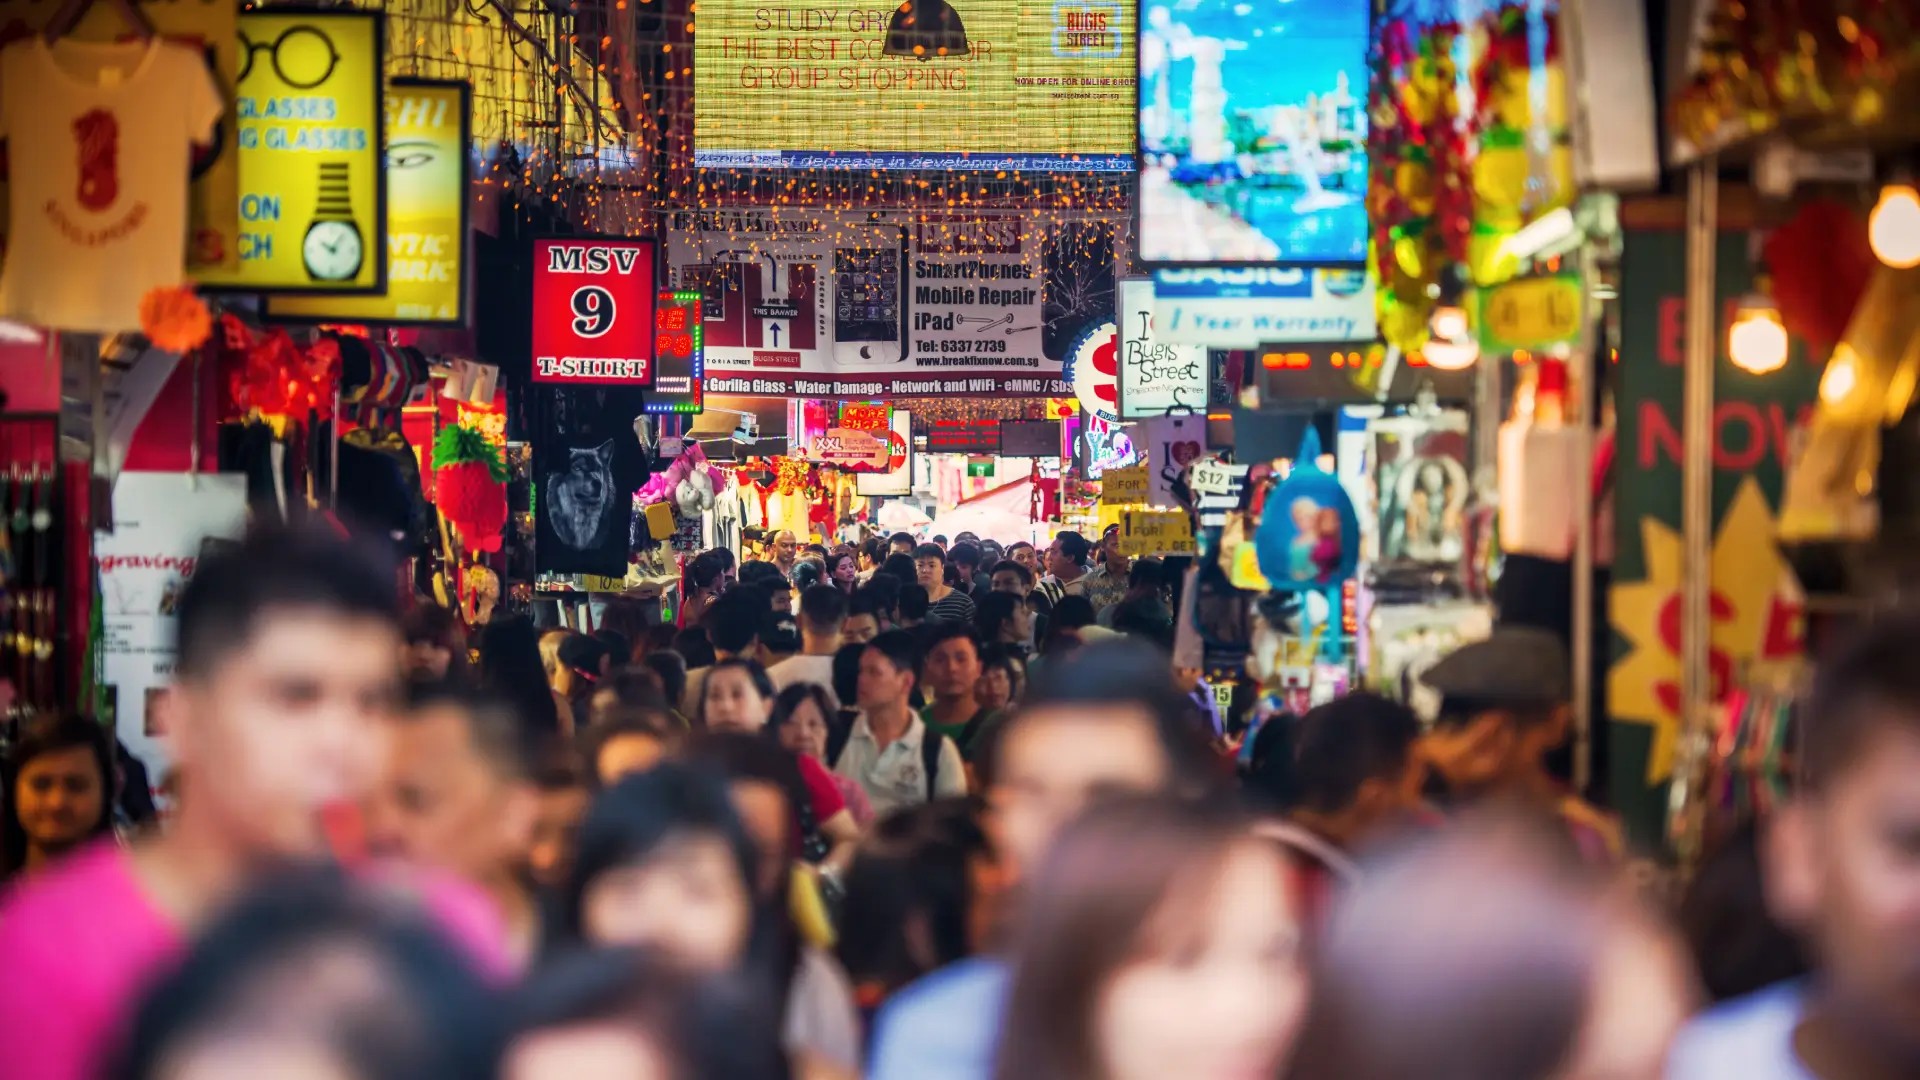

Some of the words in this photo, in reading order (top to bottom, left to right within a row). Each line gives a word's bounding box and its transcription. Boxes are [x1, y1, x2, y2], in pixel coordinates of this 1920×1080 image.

[755, 8, 838, 31] STUDY
[1066, 12, 1107, 31] BUGIS
[719, 36, 768, 60] THE
[776, 37, 841, 60] BEST
[1066, 32, 1105, 47] STREET
[741, 65, 829, 89] GROUP
[838, 66, 967, 90] SHOPPING
[1036, 77, 1059, 86] OPEN
[1061, 77, 1078, 86] FOR
[264, 128, 367, 150] GLASSES
[801, 155, 884, 168] decrease
[888, 156, 906, 168] in
[909, 156, 1028, 170] development
[1032, 158, 1105, 171] charges
[548, 246, 640, 275] MSV
[915, 260, 1033, 279] SmartPhones
[915, 286, 975, 305] Mobile
[978, 286, 1037, 307] Repair
[571, 285, 617, 339] 9
[753, 307, 768, 316] THIS
[770, 308, 798, 317] BANNER
[914, 312, 954, 331] iPad
[1138, 311, 1150, 341] I
[915, 340, 938, 352] Tel:
[941, 340, 972, 352] 6337
[975, 340, 1006, 352] 2739
[537, 356, 646, 378] T-SHIRT
[915, 356, 1039, 367] www.breakfixnow.com.sg
[1140, 358, 1199, 385] Street
[709, 378, 750, 392] Gorilla
[752, 379, 786, 393] Glass
[794, 380, 832, 394] Water
[834, 381, 883, 395] Damage
[891, 380, 942, 393] Network
[943, 380, 966, 392] and
[968, 378, 995, 391] WiFi
[1004, 379, 1041, 392] eMMC
[815, 437, 844, 451] XXL
[1198, 470, 1224, 485] $12
